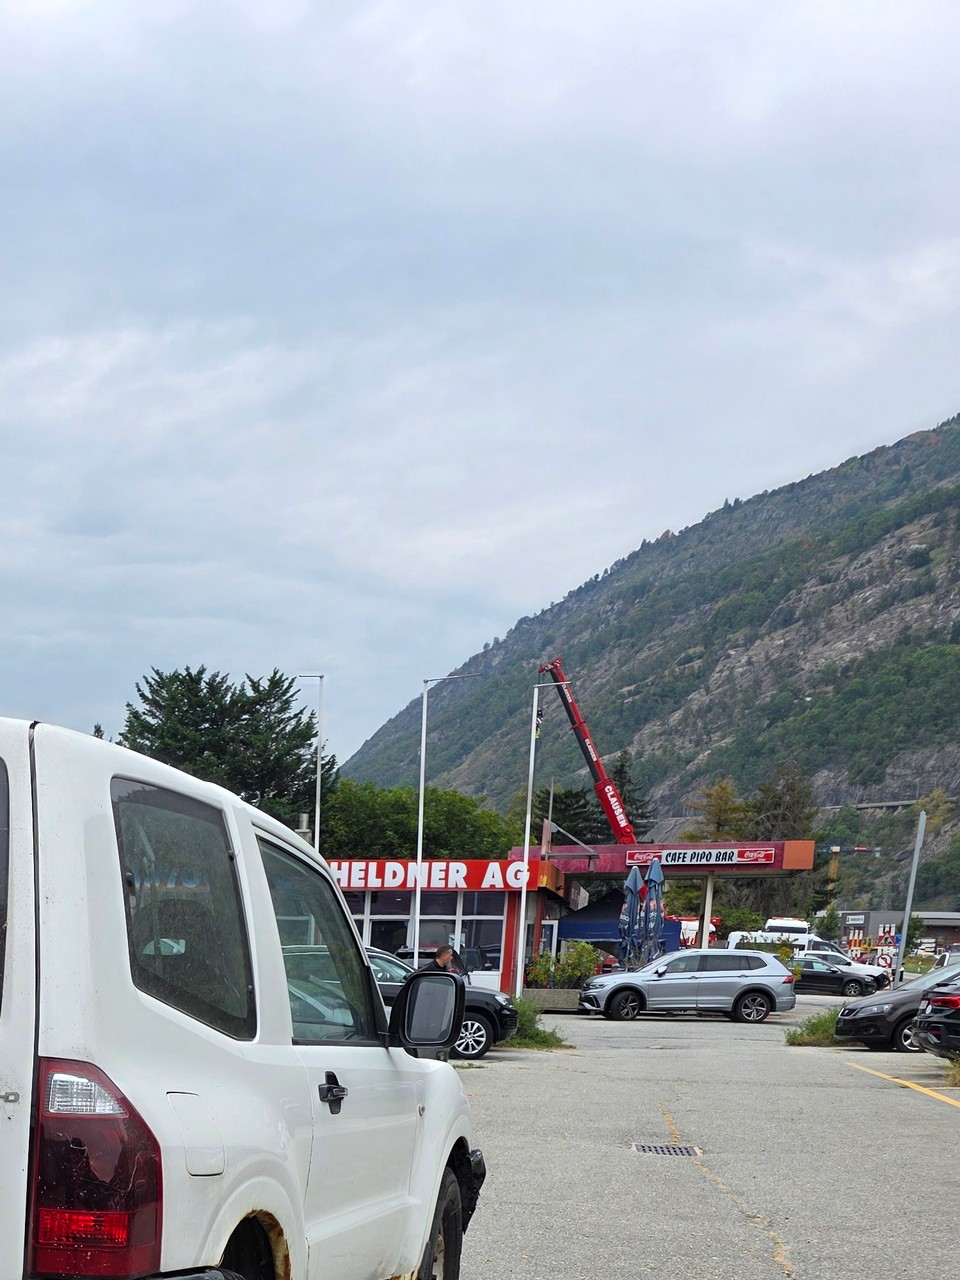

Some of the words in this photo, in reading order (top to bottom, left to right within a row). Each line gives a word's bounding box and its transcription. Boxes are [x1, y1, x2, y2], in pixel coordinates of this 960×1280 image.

[604, 785, 628, 828] CLAUSEN
[665, 851, 687, 863] CAFE
[690, 851, 713, 863] PIPO
[715, 850, 735, 862] BAR
[329, 861, 468, 888] HELDNER
[480, 861, 531, 889] AG
